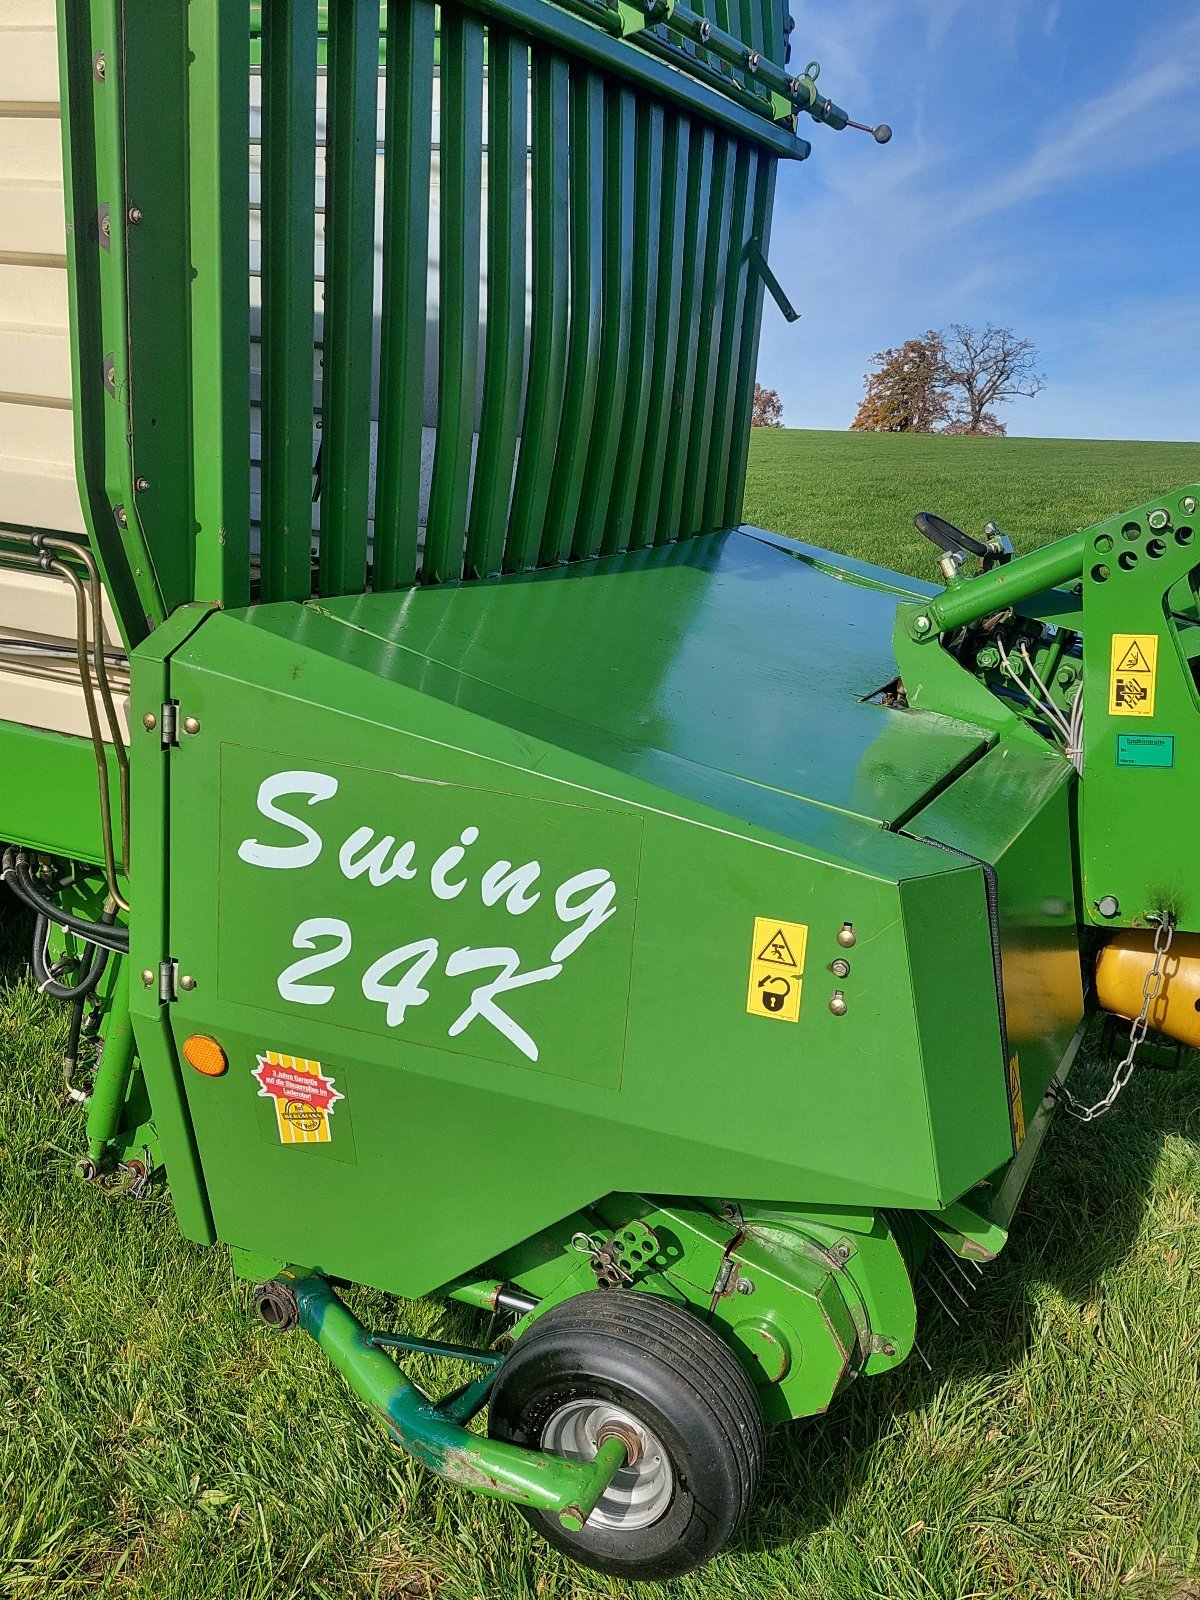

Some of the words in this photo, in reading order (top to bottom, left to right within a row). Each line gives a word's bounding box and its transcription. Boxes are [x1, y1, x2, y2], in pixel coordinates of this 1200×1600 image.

[237, 770, 617, 962] Swing
[276, 917, 563, 1062] 24K
[275, 1078, 285, 1086] die
[319, 1088, 328, 1096] im
[277, 1071, 293, 1080] Jahre
[294, 1074, 318, 1086] Garantie
